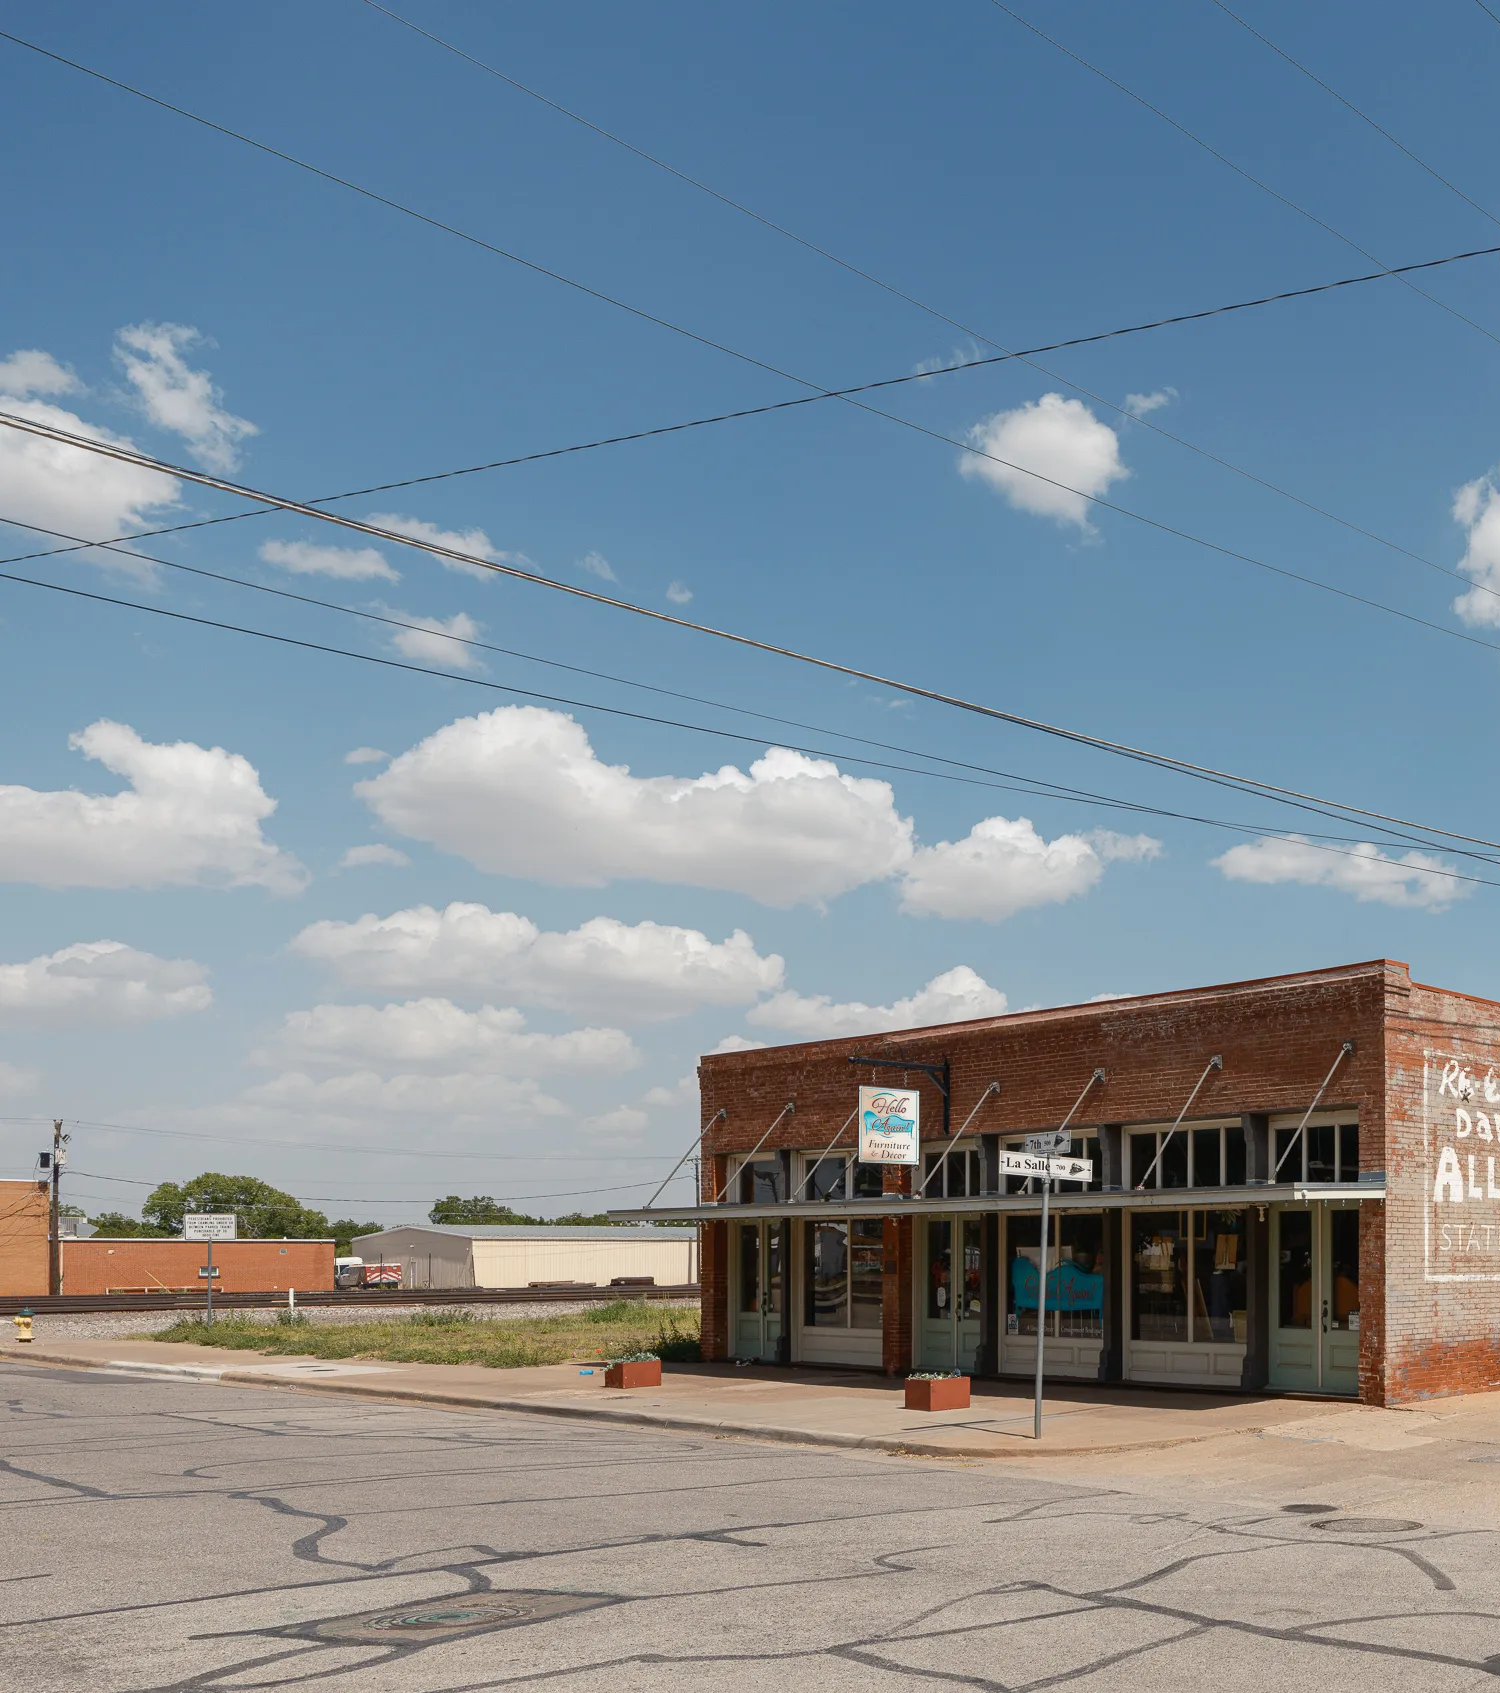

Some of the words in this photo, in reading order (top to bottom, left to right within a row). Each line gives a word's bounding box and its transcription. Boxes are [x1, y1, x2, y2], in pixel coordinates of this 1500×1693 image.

[872, 1098, 909, 1114] Hello
[872, 1118, 909, 1135] Again!
[869, 1140, 910, 1150] Furniture
[1030, 1140, 1041, 1149] 7th
[1006, 1157, 1021, 1169] La
[1025, 1158, 1050, 1171] Salle
